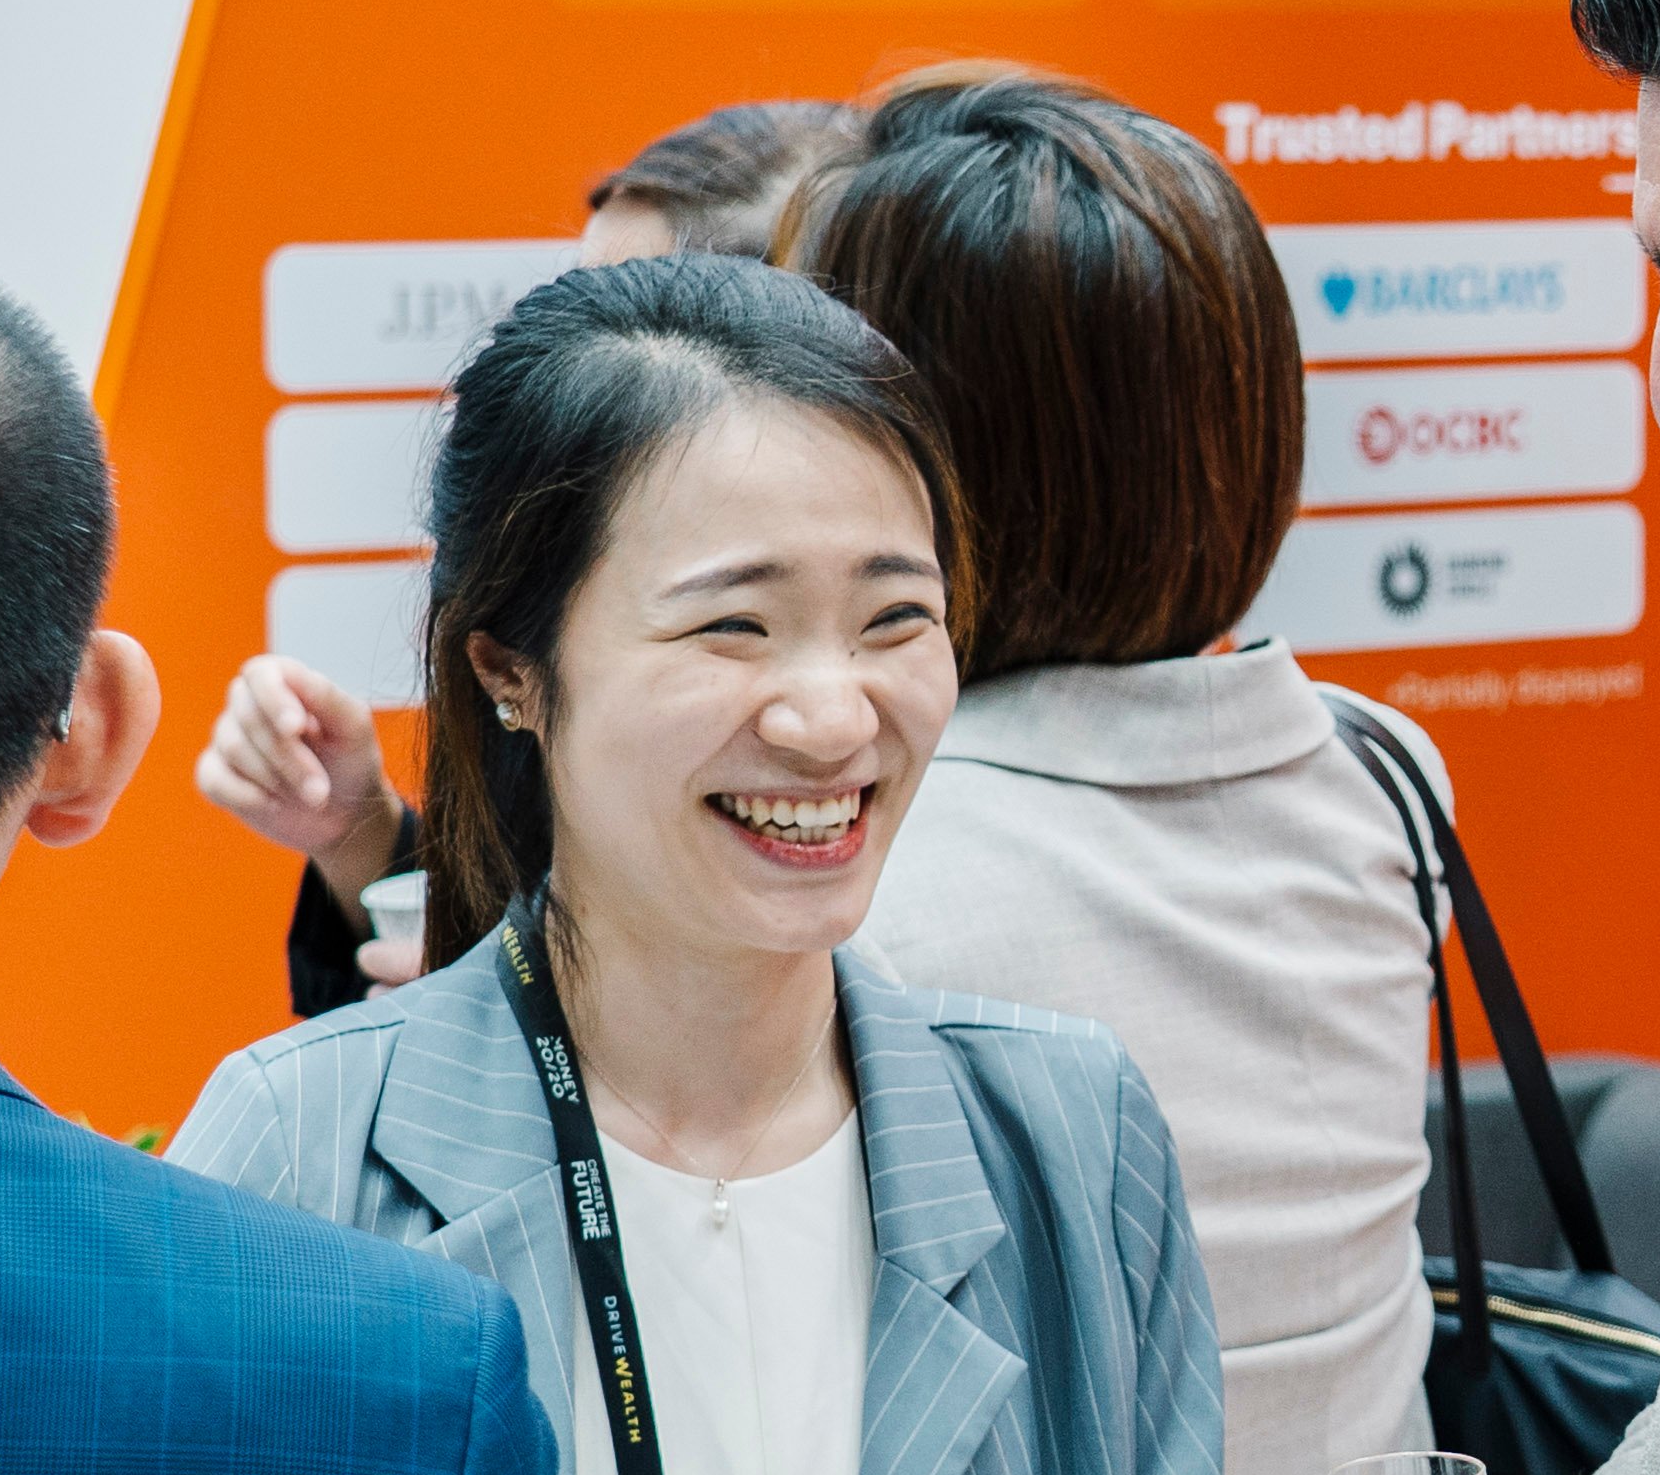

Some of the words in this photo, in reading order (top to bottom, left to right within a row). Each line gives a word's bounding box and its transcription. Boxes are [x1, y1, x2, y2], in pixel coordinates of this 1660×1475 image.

[1216, 101, 1426, 165] Trusted
[1429, 100, 1638, 161] Partners
[1369, 261, 1567, 315] BARCLAYS
[1409, 408, 1524, 457] OCBC
[502, 924, 534, 987] WEALTH
[536, 1036, 565, 1099] 20/20
[550, 1036, 580, 1105] MONEY
[571, 1159, 601, 1241] FUTURE
[587, 1158, 608, 1211] CREATE
[596, 1211, 612, 1238] THE
[604, 1295, 641, 1443] DRIVEWEALTH
